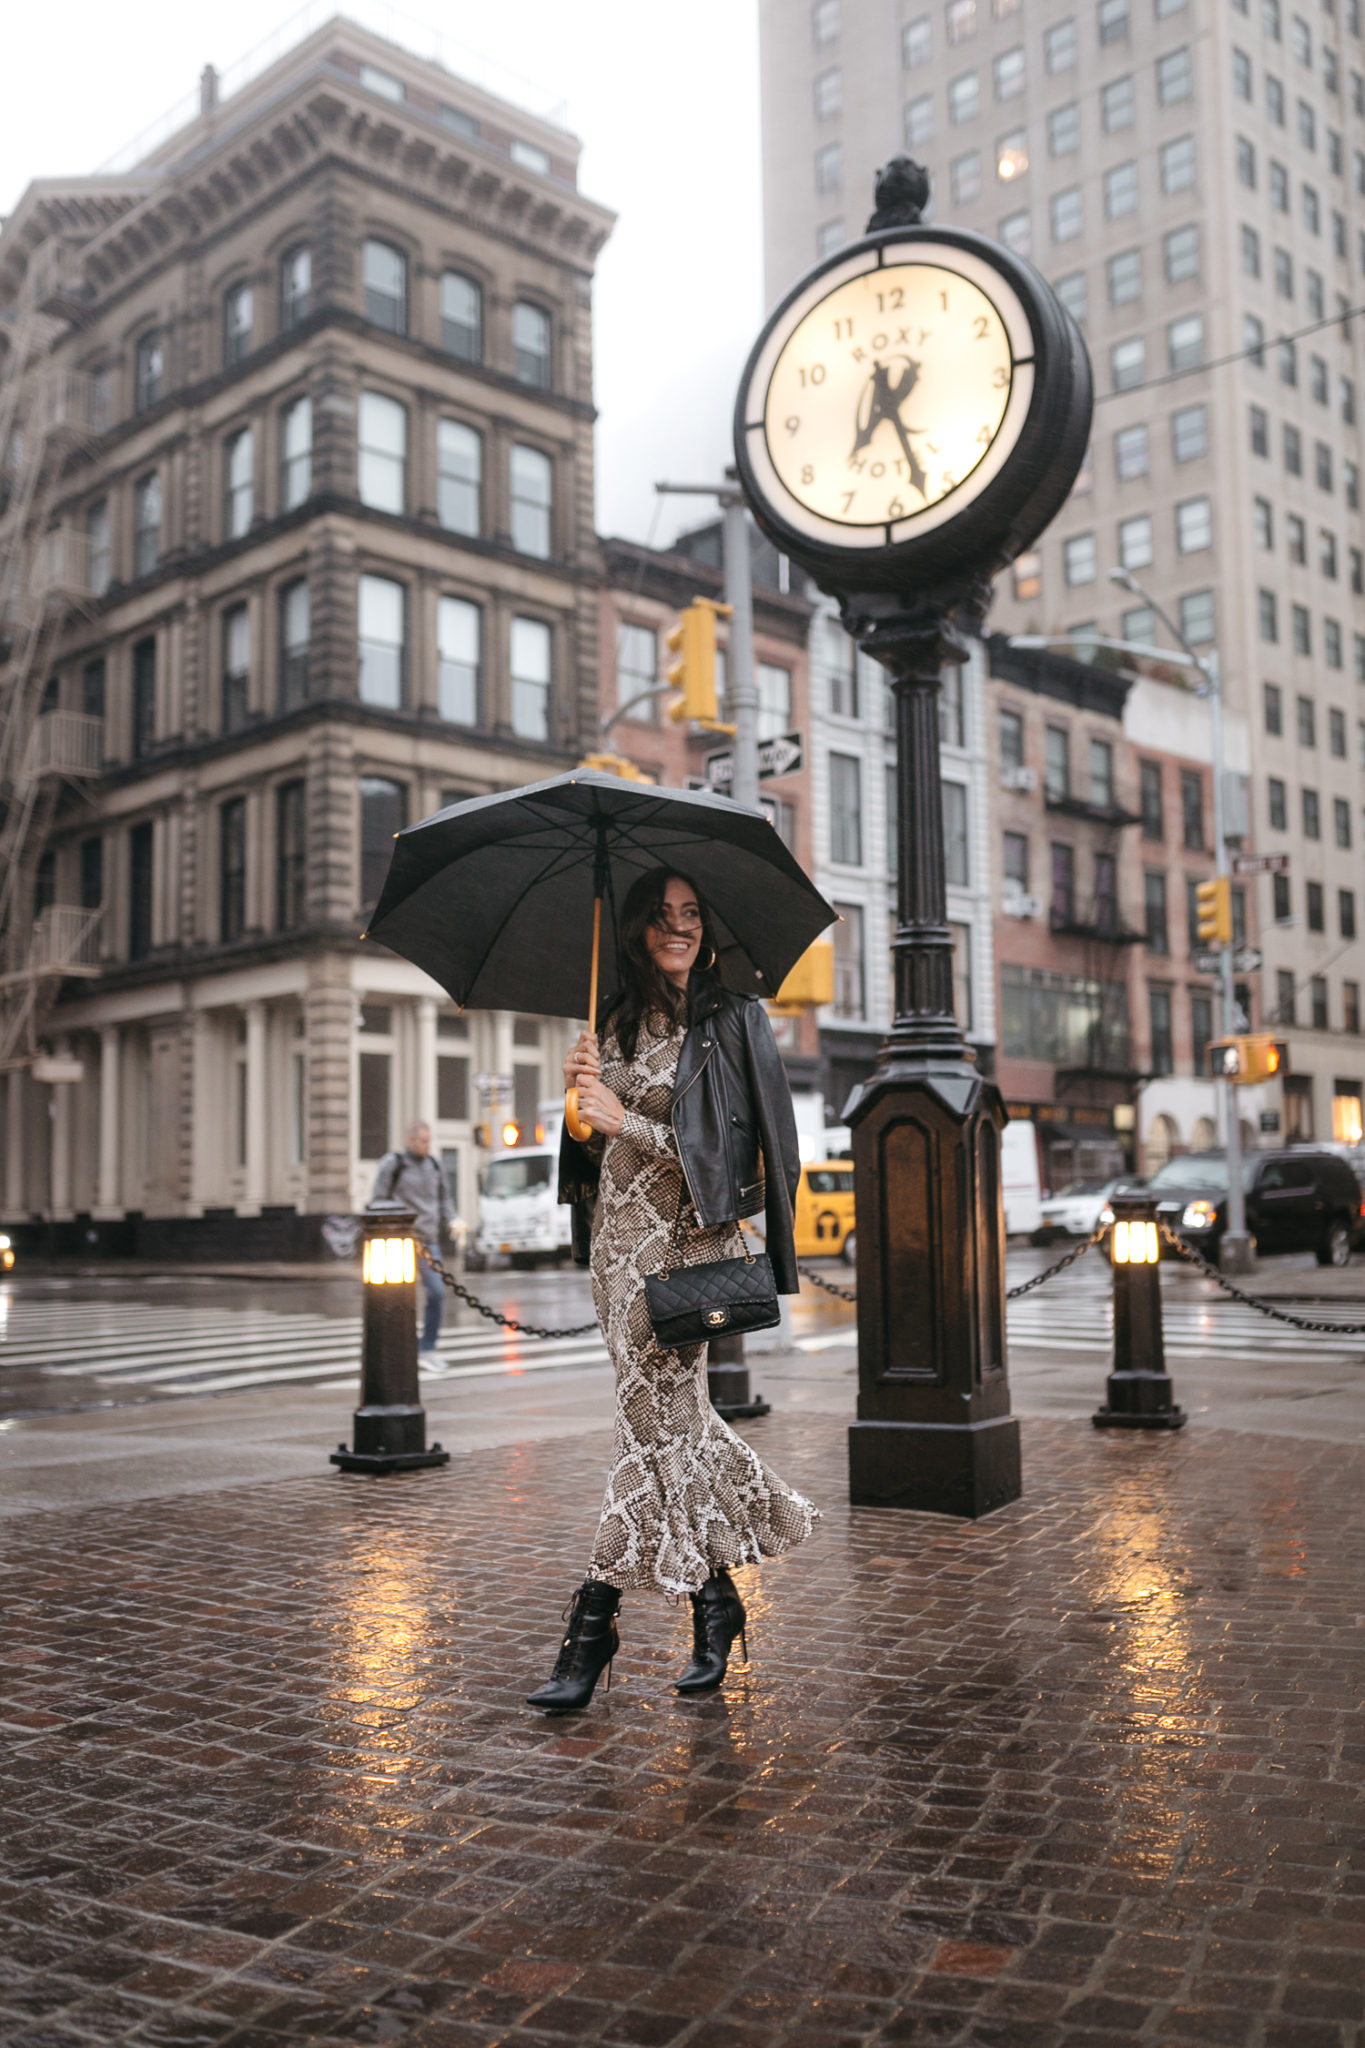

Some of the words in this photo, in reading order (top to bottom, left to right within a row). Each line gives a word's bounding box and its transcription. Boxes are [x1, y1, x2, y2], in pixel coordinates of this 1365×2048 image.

[876, 287, 905, 313] 12
[939, 290, 949, 312] 1
[834, 317, 854, 341] 11
[973, 316, 990, 340] 2
[852, 327, 932, 363] ROXY
[799, 364, 826, 389] 10
[993, 367, 1010, 390] 3
[785, 414, 801, 438] 9
[975, 424, 993, 446] 4
[801, 464, 815, 485] 8
[942, 471, 957, 495] 5
[842, 490, 857, 515] 7
[888, 496, 905, 520] 6
